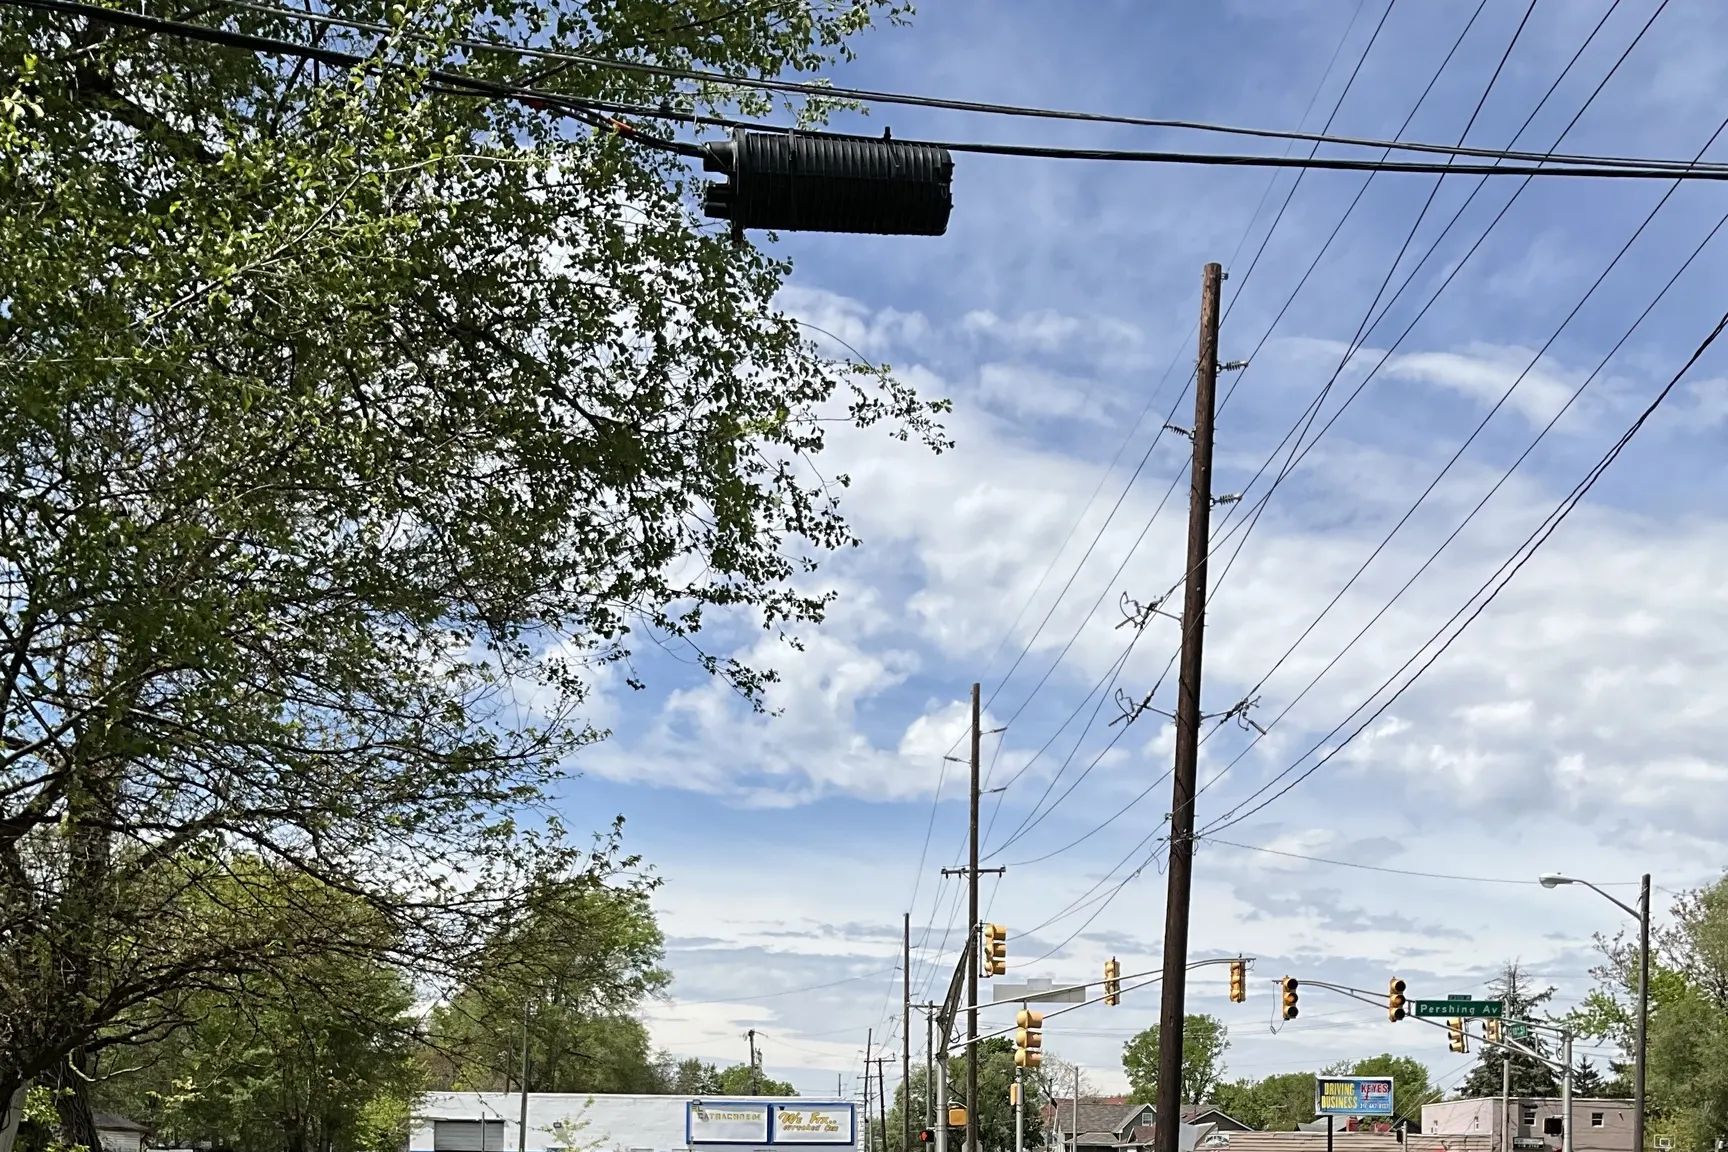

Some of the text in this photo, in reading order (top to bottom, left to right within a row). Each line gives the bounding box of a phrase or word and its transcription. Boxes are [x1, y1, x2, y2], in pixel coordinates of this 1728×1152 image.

[1420, 1004, 1498, 1015] Pershing Av
[1323, 1082, 1355, 1095] DRIVING
[1360, 1083, 1389, 1095] KEYES
[1321, 1095, 1358, 1109] BUSINESS
